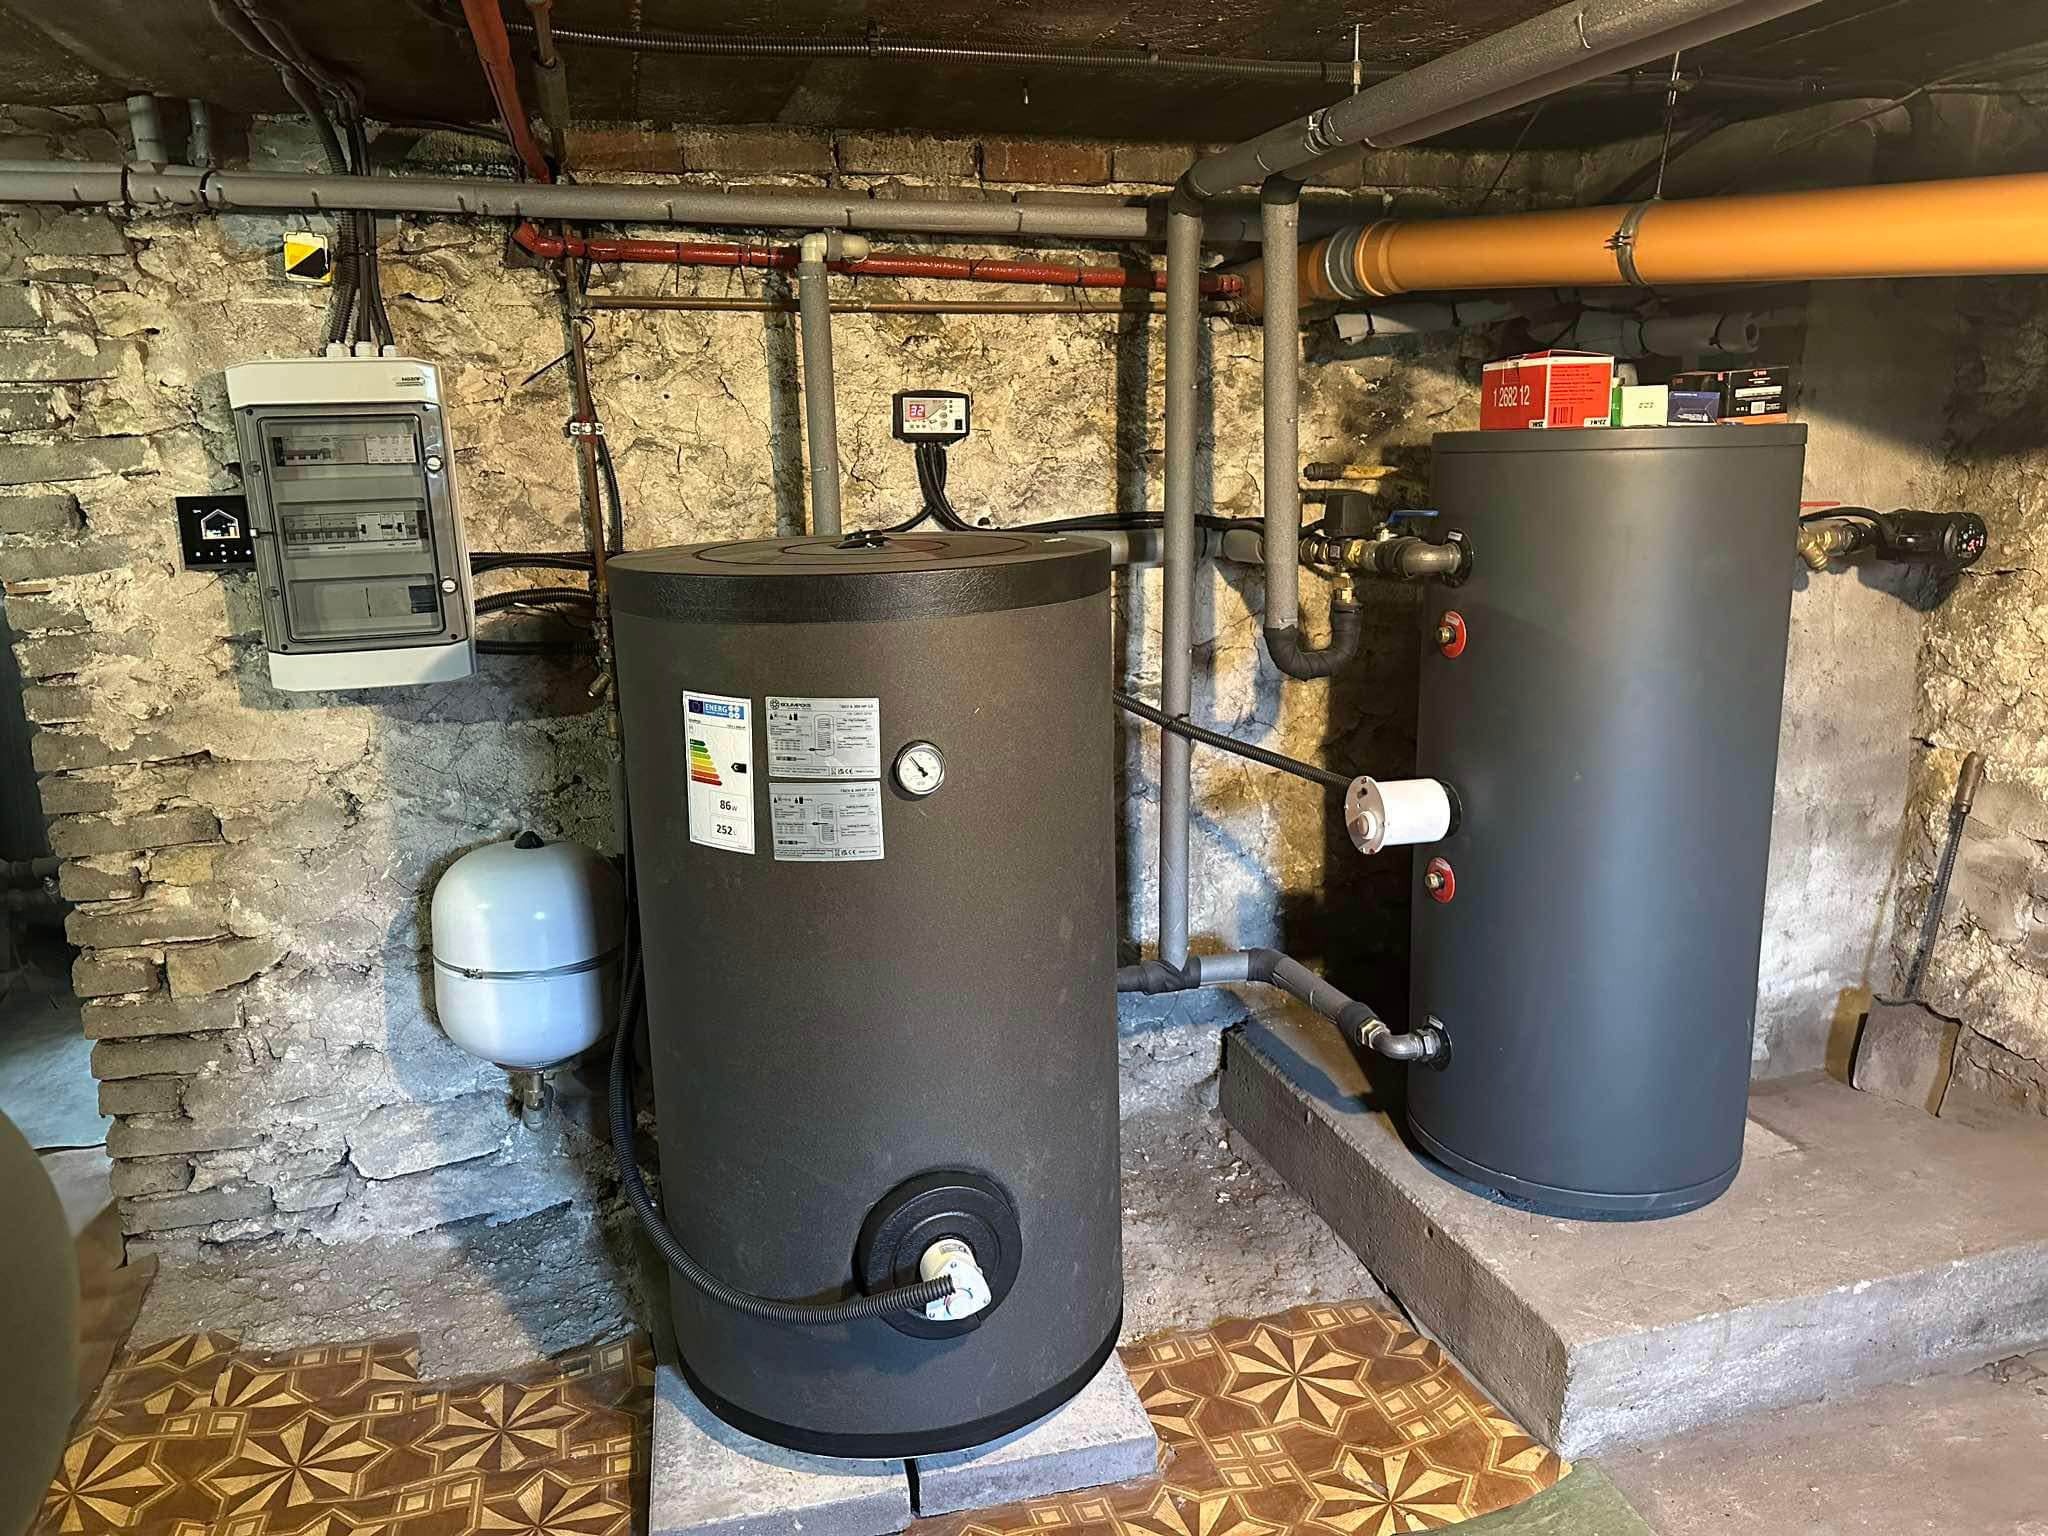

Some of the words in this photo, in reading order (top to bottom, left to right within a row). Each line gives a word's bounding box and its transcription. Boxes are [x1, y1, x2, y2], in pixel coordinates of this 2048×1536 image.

[1499, 386, 1518, 408] 2682
[1520, 384, 1531, 407] 12
[911, 405, 924, 416] 32
[705, 703, 728, 713] ENERG
[719, 800, 732, 811] 86
[716, 824, 733, 836] 252
